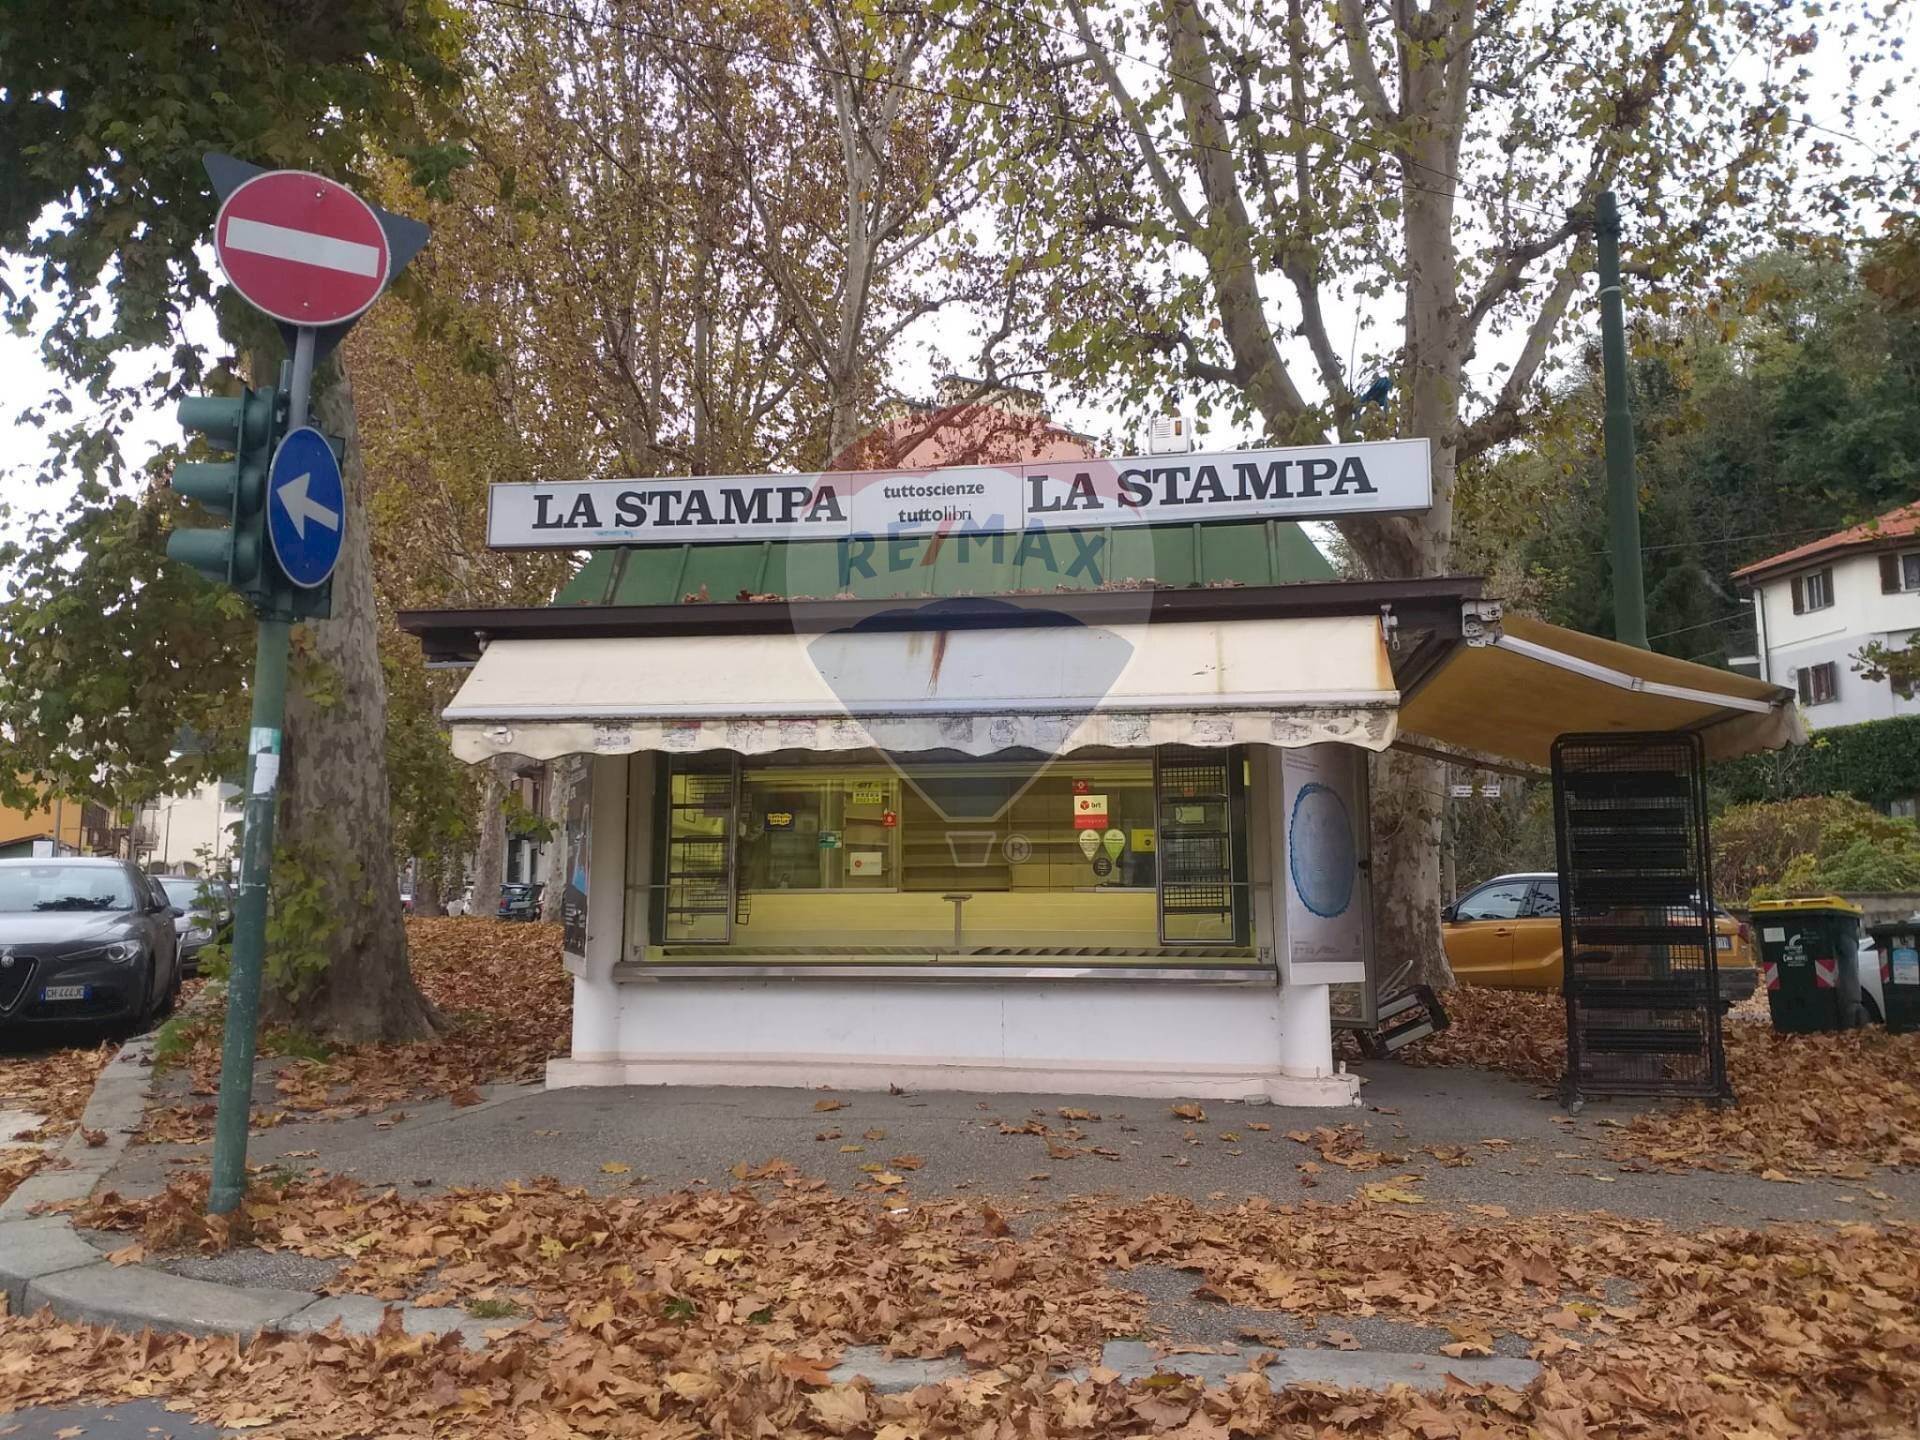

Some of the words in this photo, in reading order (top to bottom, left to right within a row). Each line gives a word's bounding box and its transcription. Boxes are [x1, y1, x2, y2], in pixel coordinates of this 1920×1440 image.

[884, 482, 985, 499] tuttoscienze
[1027, 472, 1104, 513] LA
[1117, 456, 1378, 508] STAMPA
[532, 493, 602, 529] LA
[615, 485, 847, 528] STAMPA
[898, 504, 972, 523] tuttolibri
